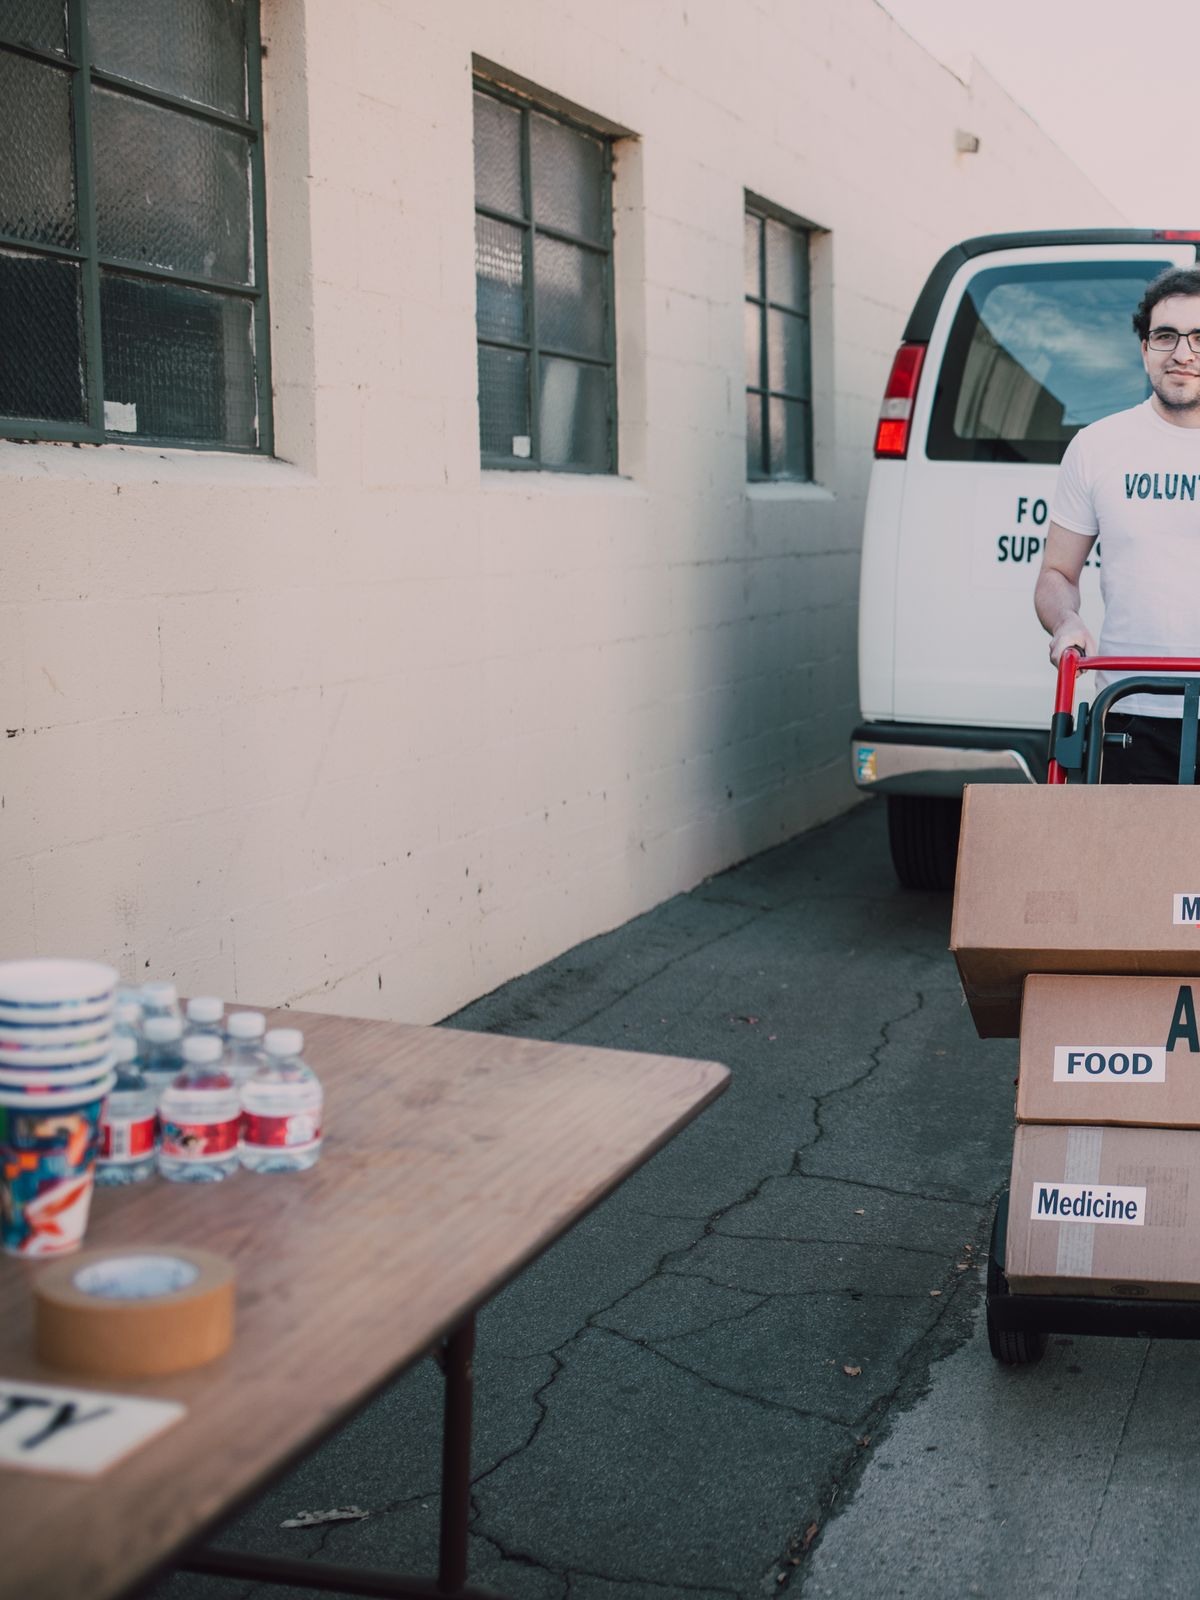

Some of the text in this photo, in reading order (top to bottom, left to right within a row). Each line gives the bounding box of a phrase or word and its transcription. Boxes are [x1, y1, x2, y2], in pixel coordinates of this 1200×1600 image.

[1017, 497, 1047, 525] FO
[1067, 1052, 1153, 1075] FOOD
[1037, 1188, 1138, 1220] Medicine
[0, 1393, 113, 1450] TY
